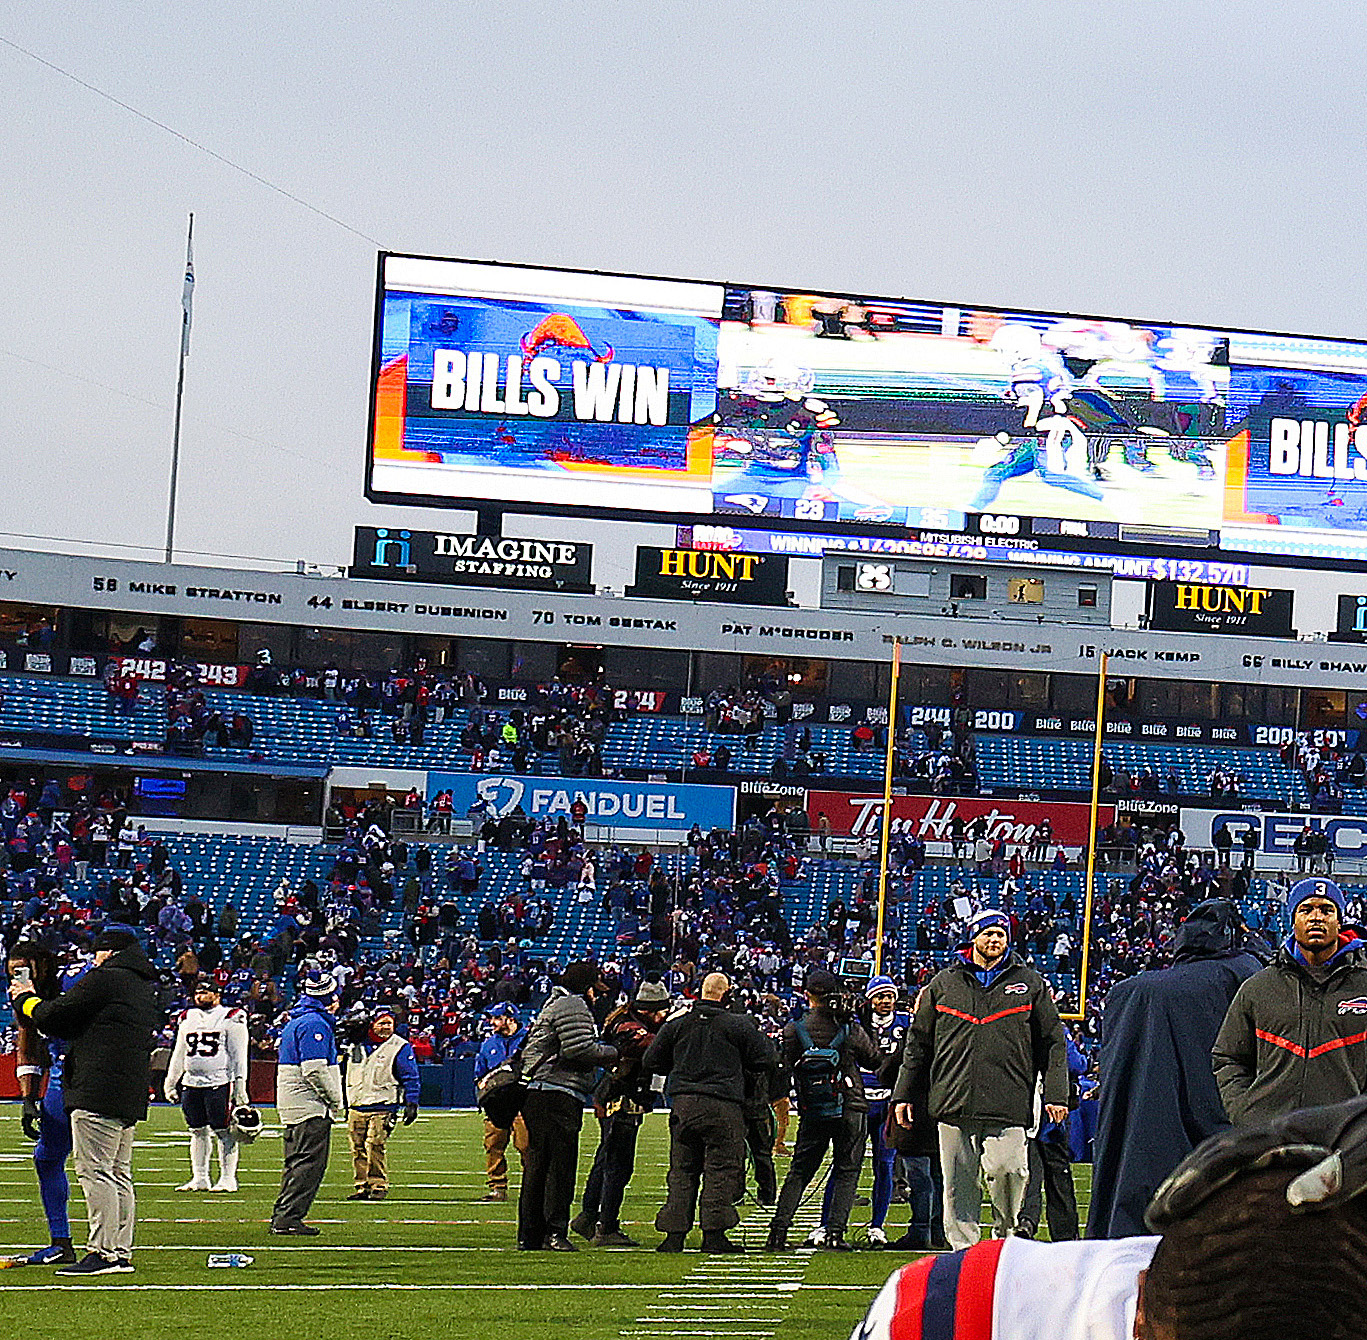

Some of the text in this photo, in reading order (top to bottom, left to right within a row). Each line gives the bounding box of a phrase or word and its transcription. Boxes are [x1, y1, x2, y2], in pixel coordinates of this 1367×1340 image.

[432, 348, 670, 426] BILLS WIN
[979, 514, 1020, 535] 0:00
[434, 534, 577, 565] IMAGINE
[919, 531, 1039, 551] MITSUBISHI ELECTRIC
[455, 560, 552, 578] STAFFING
[659, 550, 762, 581] HUNT
[94, 577, 281, 604] 58 MIKE STRATTON
[680, 580, 740, 593] Since 1911
[308, 596, 507, 620] 44 ELBERT DUBENION
[1175, 584, 1268, 615] HUNT
[532, 611, 676, 630] 70 TOM SESTAK
[722, 621, 752, 635] PAT
[1194, 612, 1249, 626] Since 1911
[882, 635, 935, 647] RALPH
[962, 640, 1025, 652] WILSON
[1030, 645, 1051, 653] JR
[1078, 644, 1199, 662] 15 JACK KEMP
[121, 659, 165, 680] 242
[1243, 655, 1367, 672] 66 BILLY SHAW
[975, 711, 1014, 729] 200
[1036, 718, 1061, 729] Blue
[1107, 722, 1131, 734] Blue
[1142, 725, 1167, 735] Blue
[1176, 727, 1201, 737] Blue
[532, 790, 685, 823] FANDUEL
[1315, 883, 1327, 896] 3
[186, 1032, 220, 1057] 95
